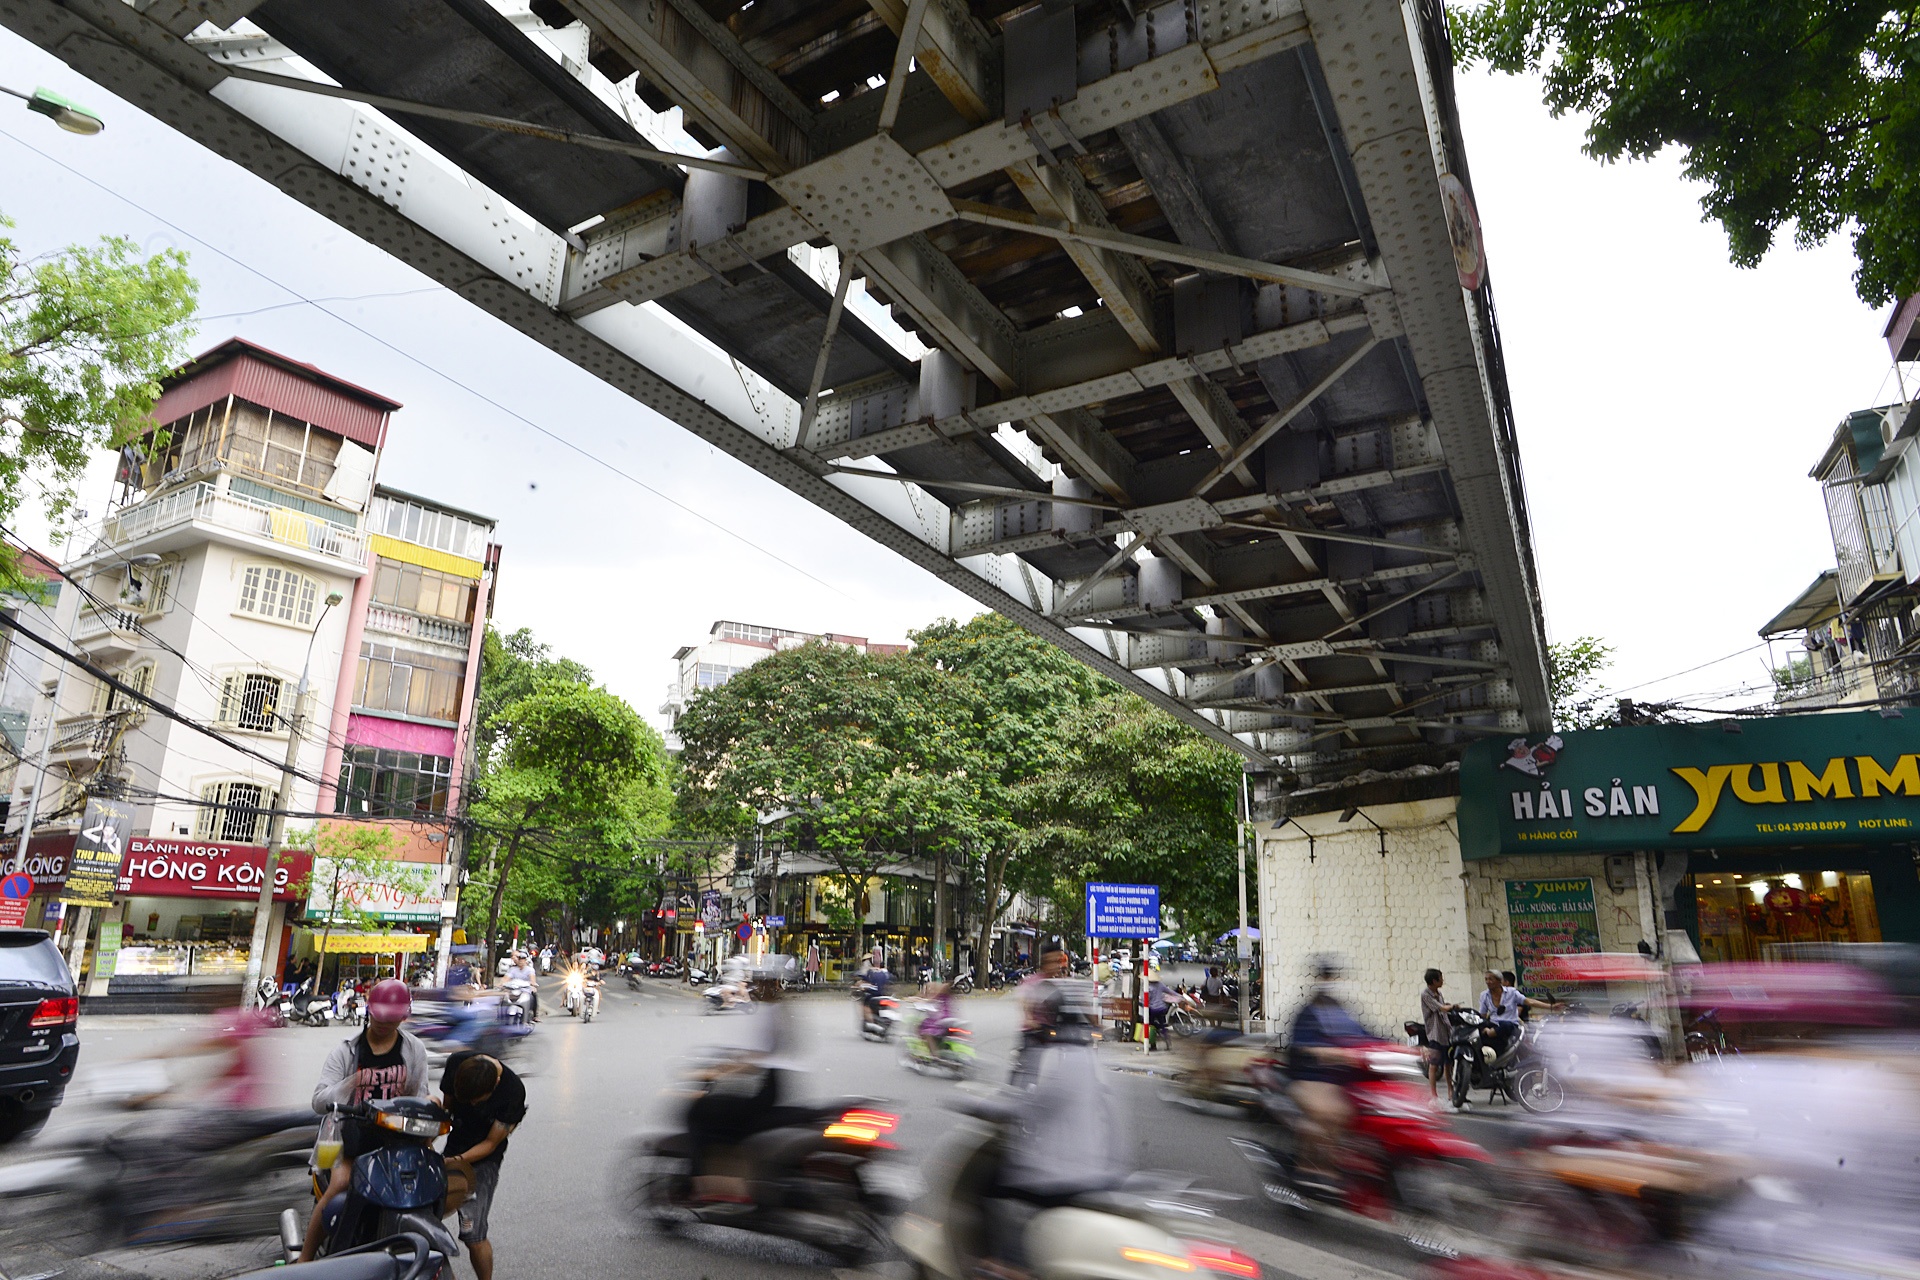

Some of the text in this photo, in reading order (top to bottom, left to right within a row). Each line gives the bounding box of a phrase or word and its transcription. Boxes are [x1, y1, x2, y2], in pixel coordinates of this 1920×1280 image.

[1511, 777, 1660, 820] HẢI SẢN
[1669, 753, 1920, 834] YUMM
[1858, 819, 1882, 829] HOT
[1517, 832, 1528, 841] 18
[1529, 830, 1557, 841] HÀNG
[75, 849, 122, 863] THU MINH
[131, 839, 231, 860] BÁNH NGỌT
[127, 854, 289, 886] HỒNG KÔNG
[1534, 881, 1588, 898] YUMMY
[1578, 899, 1594, 911] SẢN
